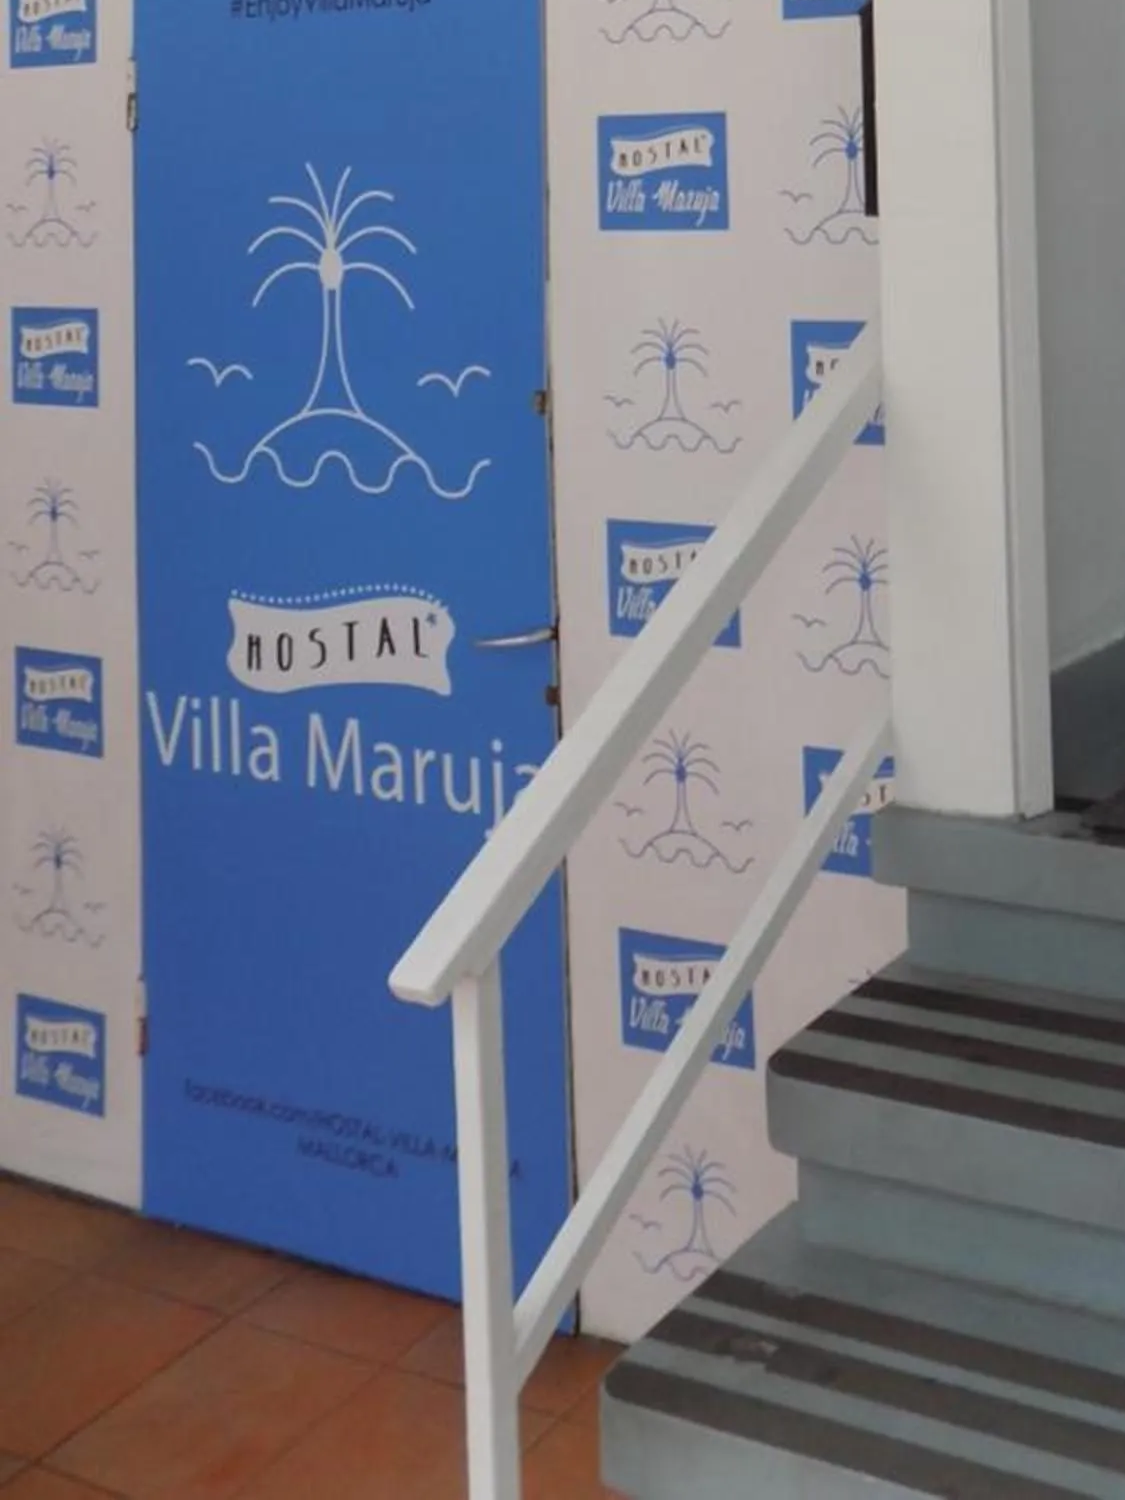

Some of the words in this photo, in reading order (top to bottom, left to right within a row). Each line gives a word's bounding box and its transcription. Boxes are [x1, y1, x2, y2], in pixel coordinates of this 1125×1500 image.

[618, 137, 704, 169] HOSTAL
[606, 179, 646, 213] Villa
[651, 179, 721, 228] Maruja
[629, 548, 698, 576] HOST
[247, 617, 429, 672] HOSTAL
[146, 690, 281, 783] Villa
[641, 966, 712, 989] HOSTA
